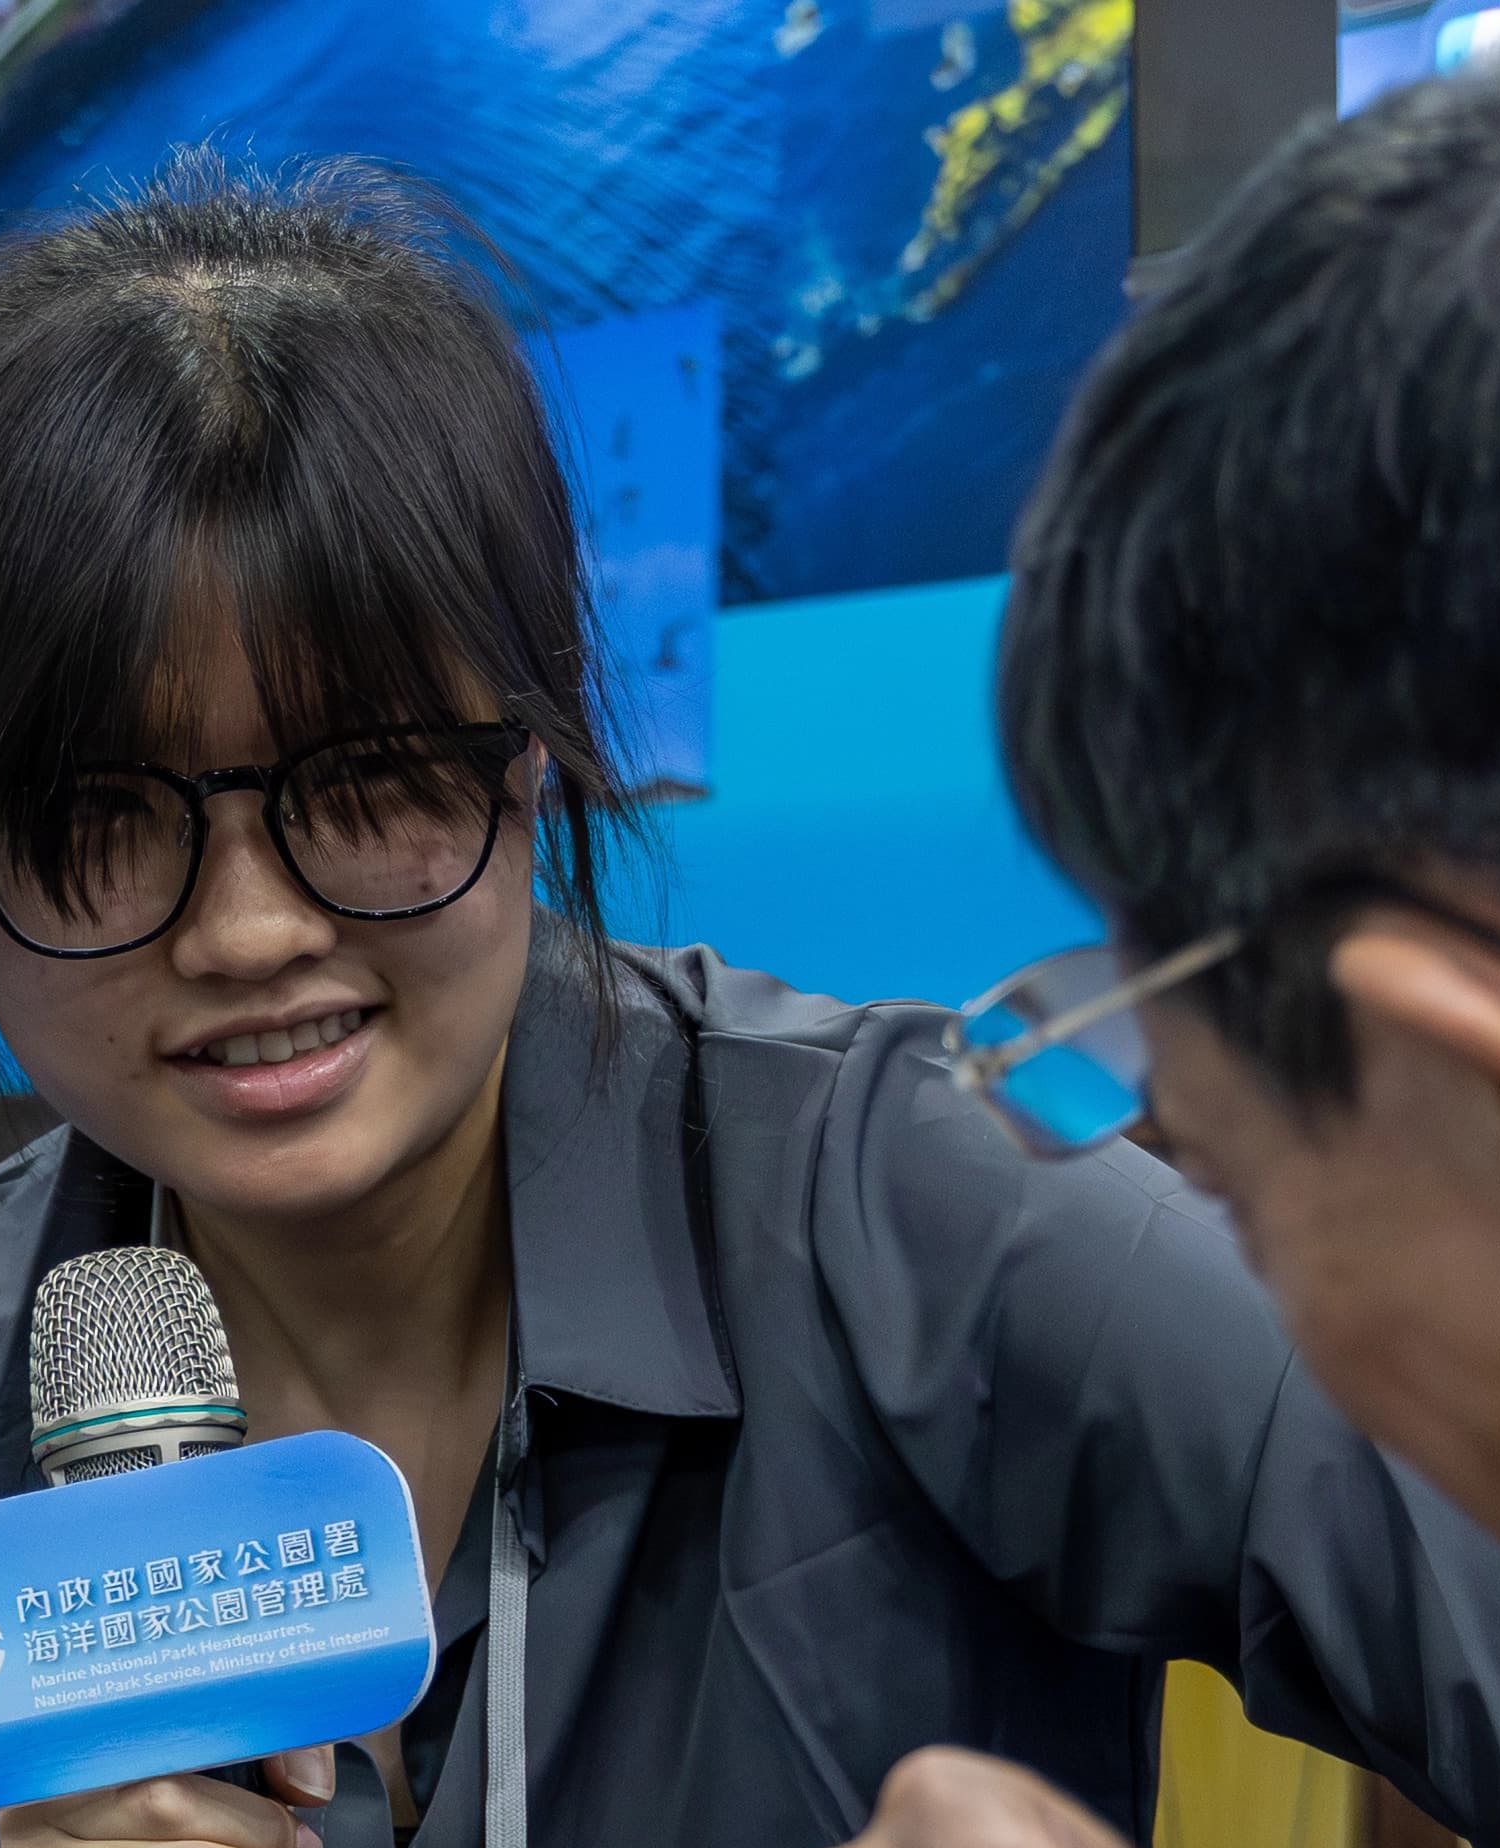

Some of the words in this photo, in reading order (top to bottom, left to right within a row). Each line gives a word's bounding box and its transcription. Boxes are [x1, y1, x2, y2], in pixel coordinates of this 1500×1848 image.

[16, 1519, 361, 1624] 內政部國家公園署
[22, 1563, 370, 1666] 海洋國家公園管理處
[31, 1669, 88, 1690] Marine
[89, 1652, 158, 1678] National
[160, 1643, 198, 1663] Park
[33, 1685, 103, 1710] National
[104, 1675, 142, 1694] Park
[143, 1665, 207, 1687] Service,
[209, 1649, 277, 1674] Ministry
[278, 1644, 298, 1660] of
[298, 1639, 328, 1656] the
[329, 1625, 392, 1650] Interior
